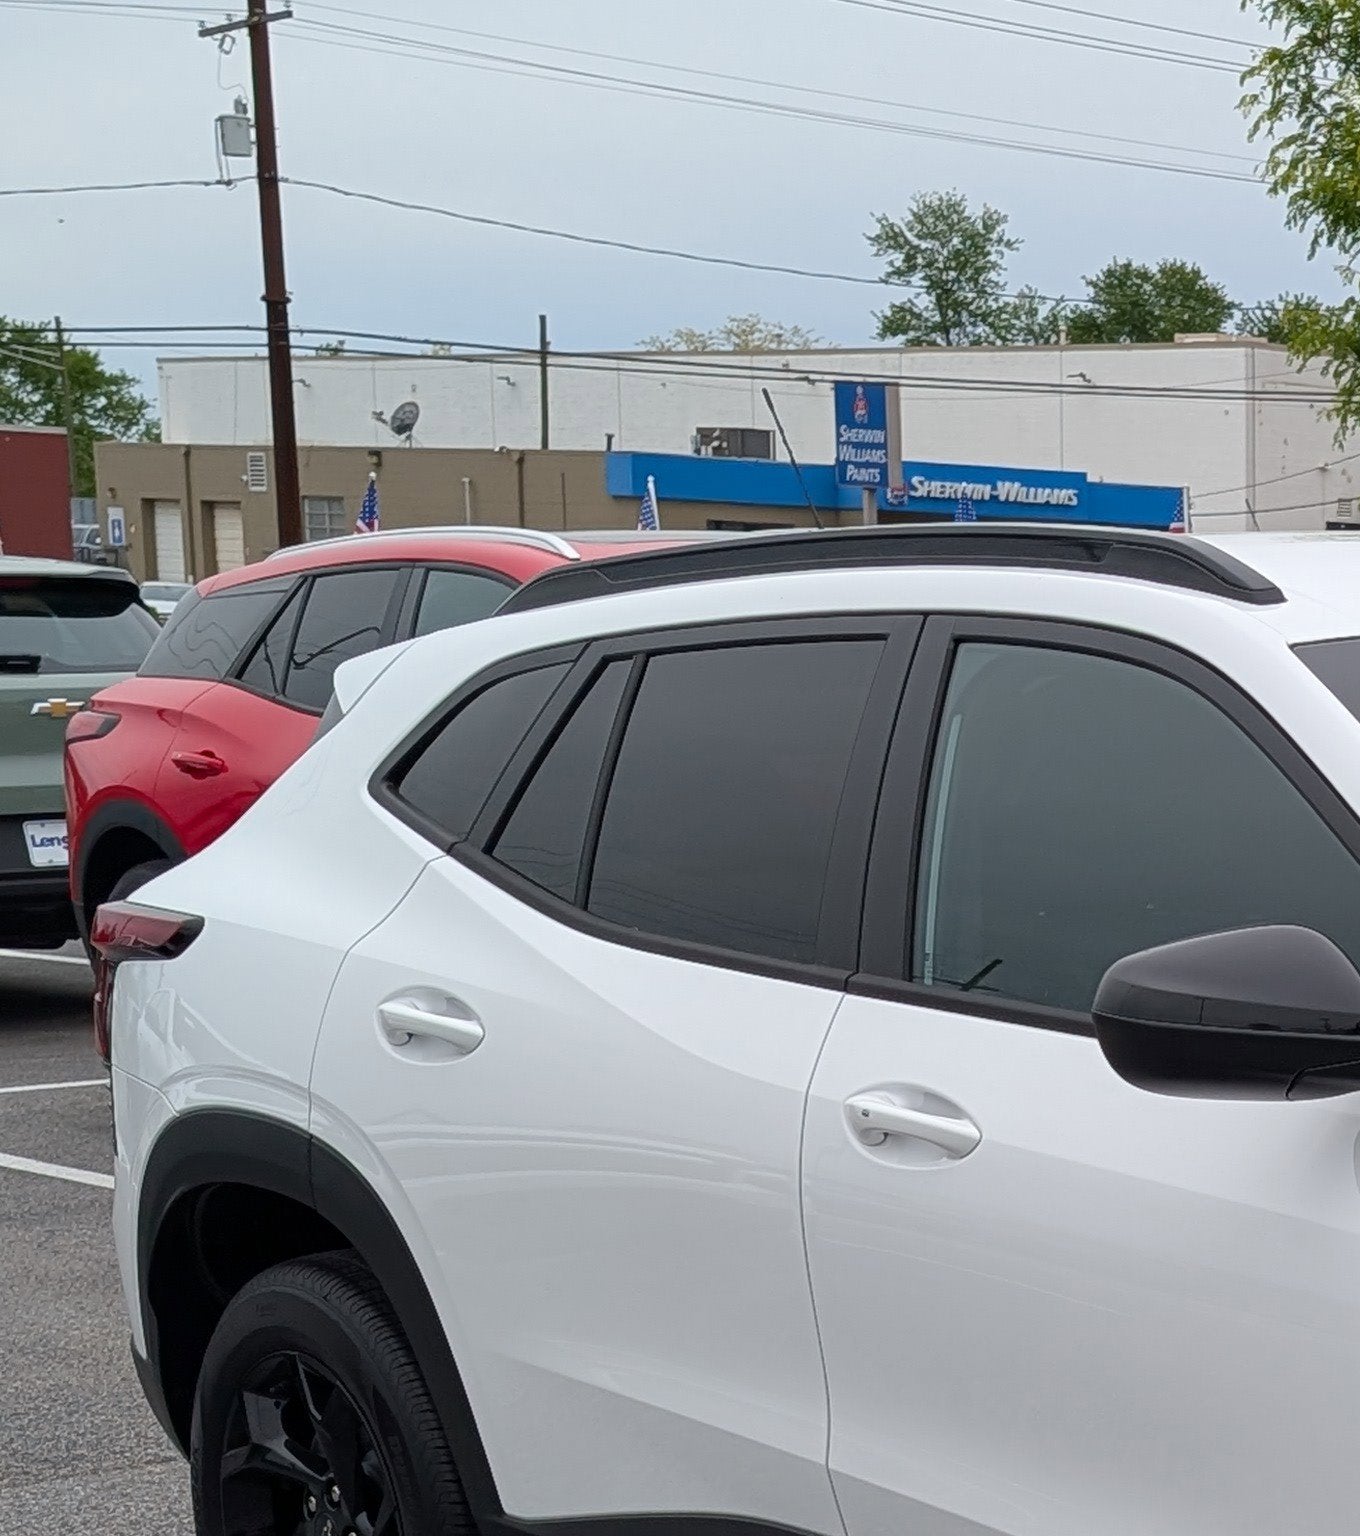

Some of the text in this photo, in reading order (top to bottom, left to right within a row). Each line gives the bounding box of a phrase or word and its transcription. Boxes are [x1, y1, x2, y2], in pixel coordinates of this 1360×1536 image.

[838, 424, 887, 444] SHERWIN
[838, 443, 888, 463] WILLIAMS
[845, 464, 881, 483] PAINTS
